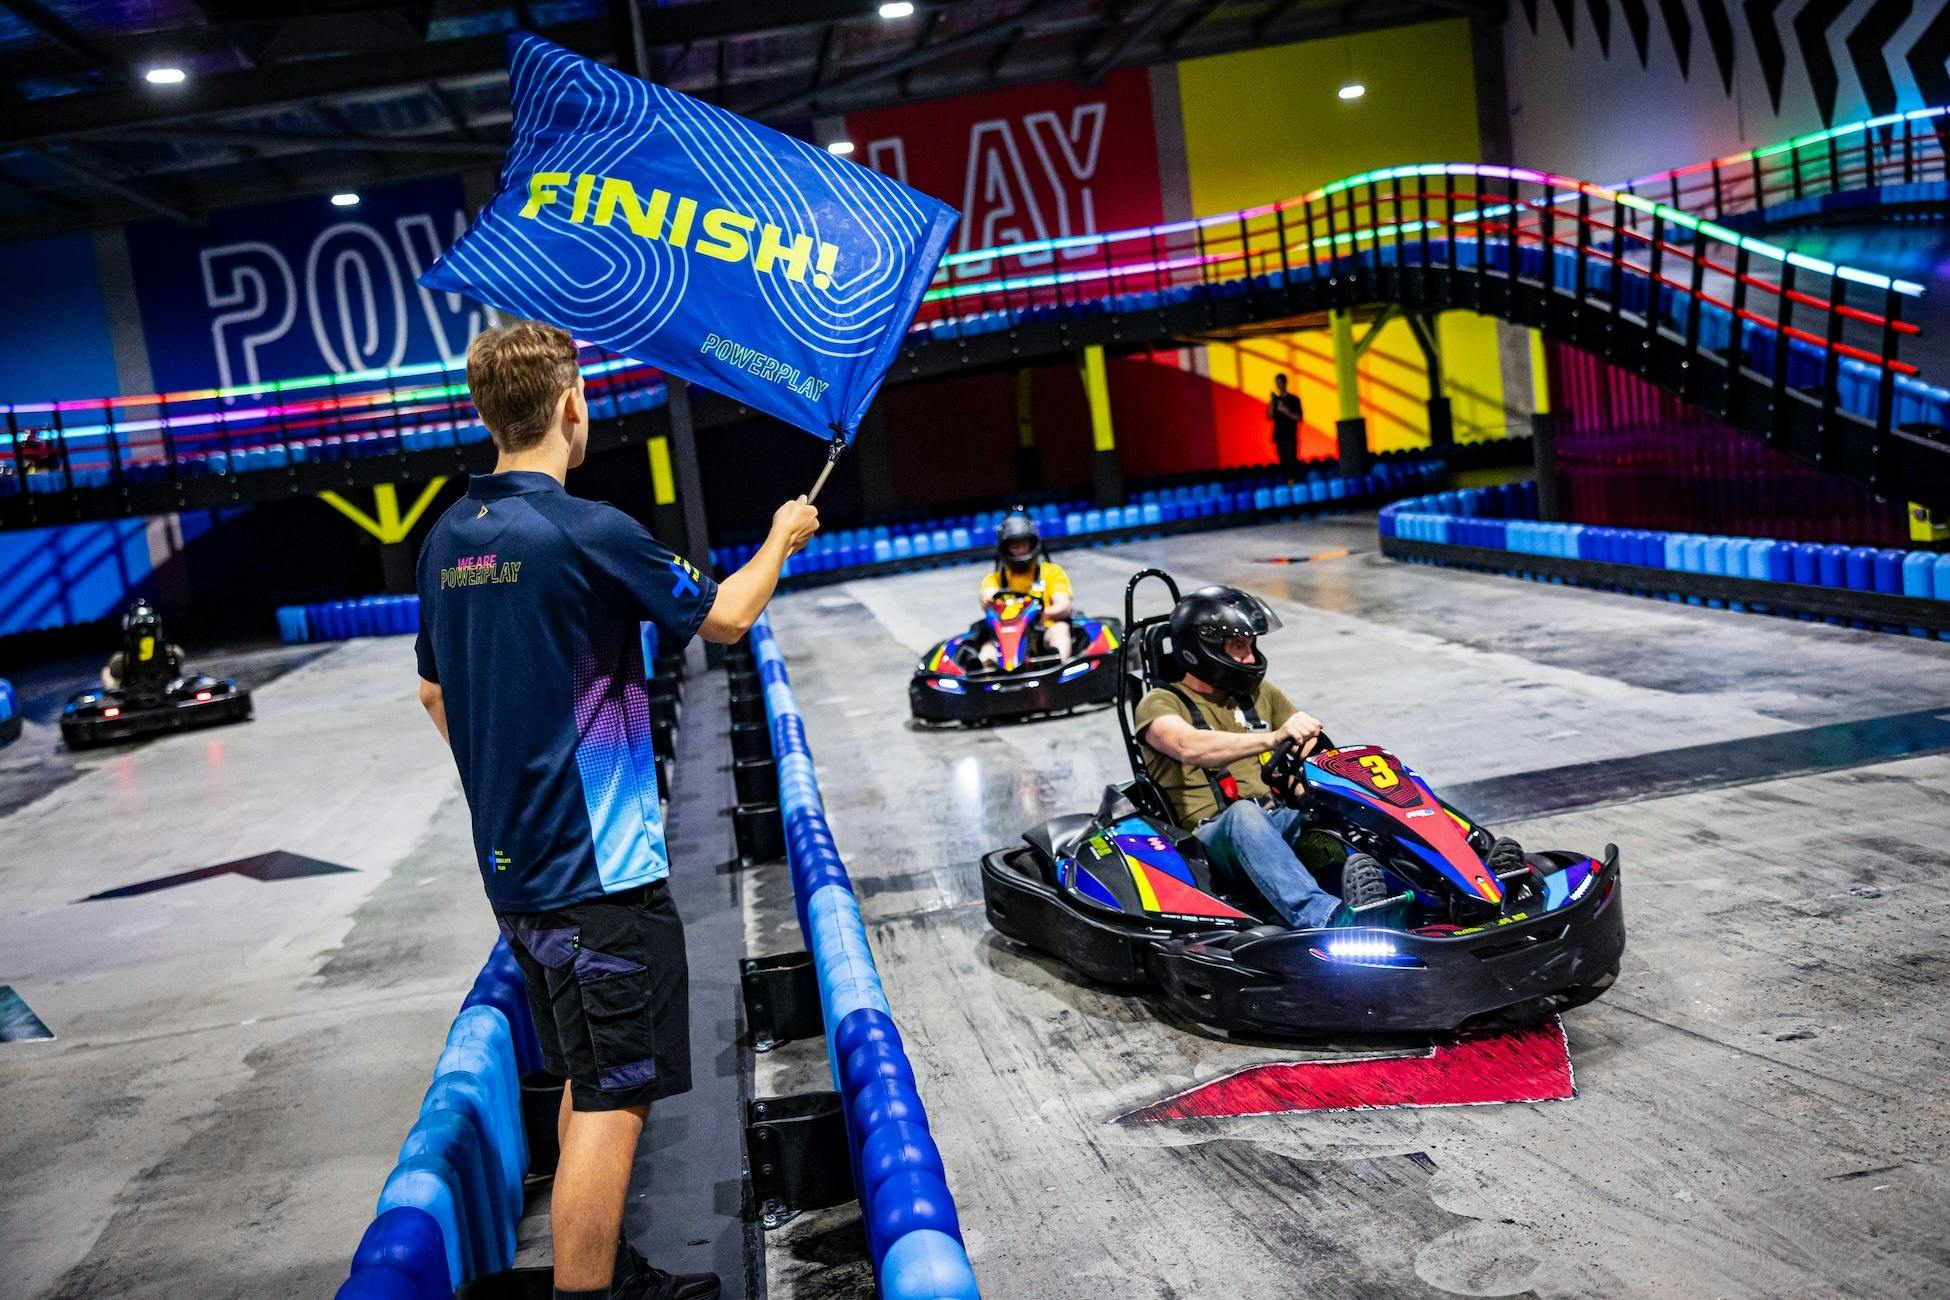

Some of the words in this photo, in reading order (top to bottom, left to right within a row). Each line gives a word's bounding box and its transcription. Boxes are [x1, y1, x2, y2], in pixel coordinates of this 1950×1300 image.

[518, 171, 839, 290] FINISH!
[700, 333, 829, 402] POWERPLAY
[440, 561, 522, 590] POWERPLAY
[457, 556, 475, 571] WE
[475, 555, 497, 569] ARE
[1358, 754, 1400, 789] 3
